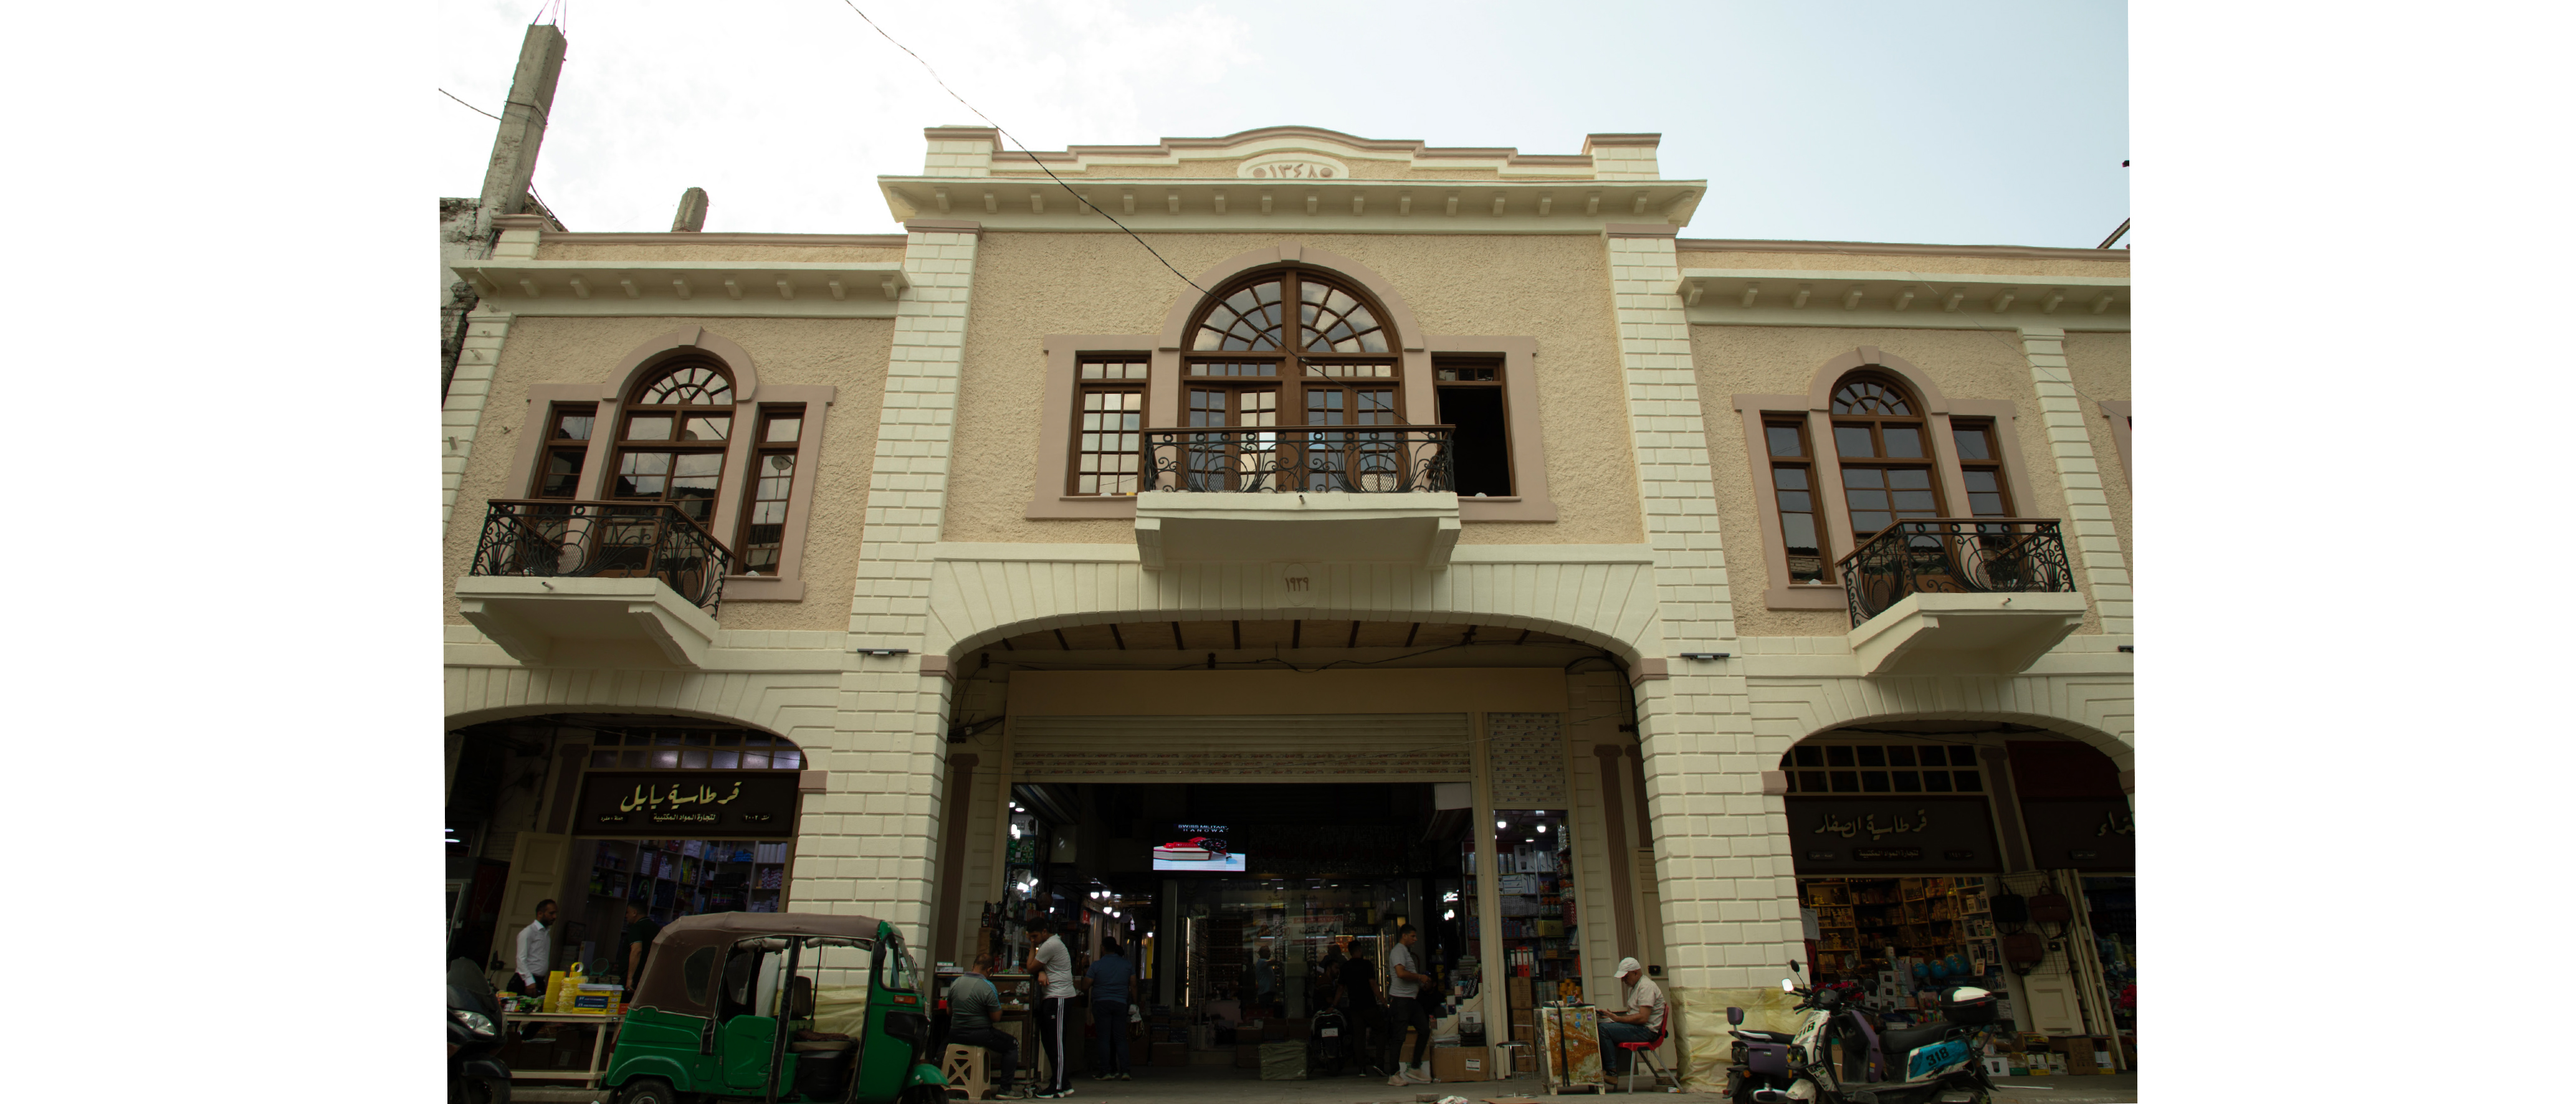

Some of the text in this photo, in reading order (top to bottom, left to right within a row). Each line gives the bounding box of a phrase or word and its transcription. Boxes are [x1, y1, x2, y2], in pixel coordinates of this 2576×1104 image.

[1269, 163, 1319, 178] ١٣٤٨
[620, 781, 743, 812] قرطاسية بابل
[653, 813, 716, 822] لتجارة المواد المكتبية
[1814, 809, 1927, 840] قرطاسية الصفار
[1858, 849, 1919, 859] لتجارة المواد المكتبية
[1341, 926, 1373, 934] LONGINES
[1925, 1047, 1949, 1067] 318
